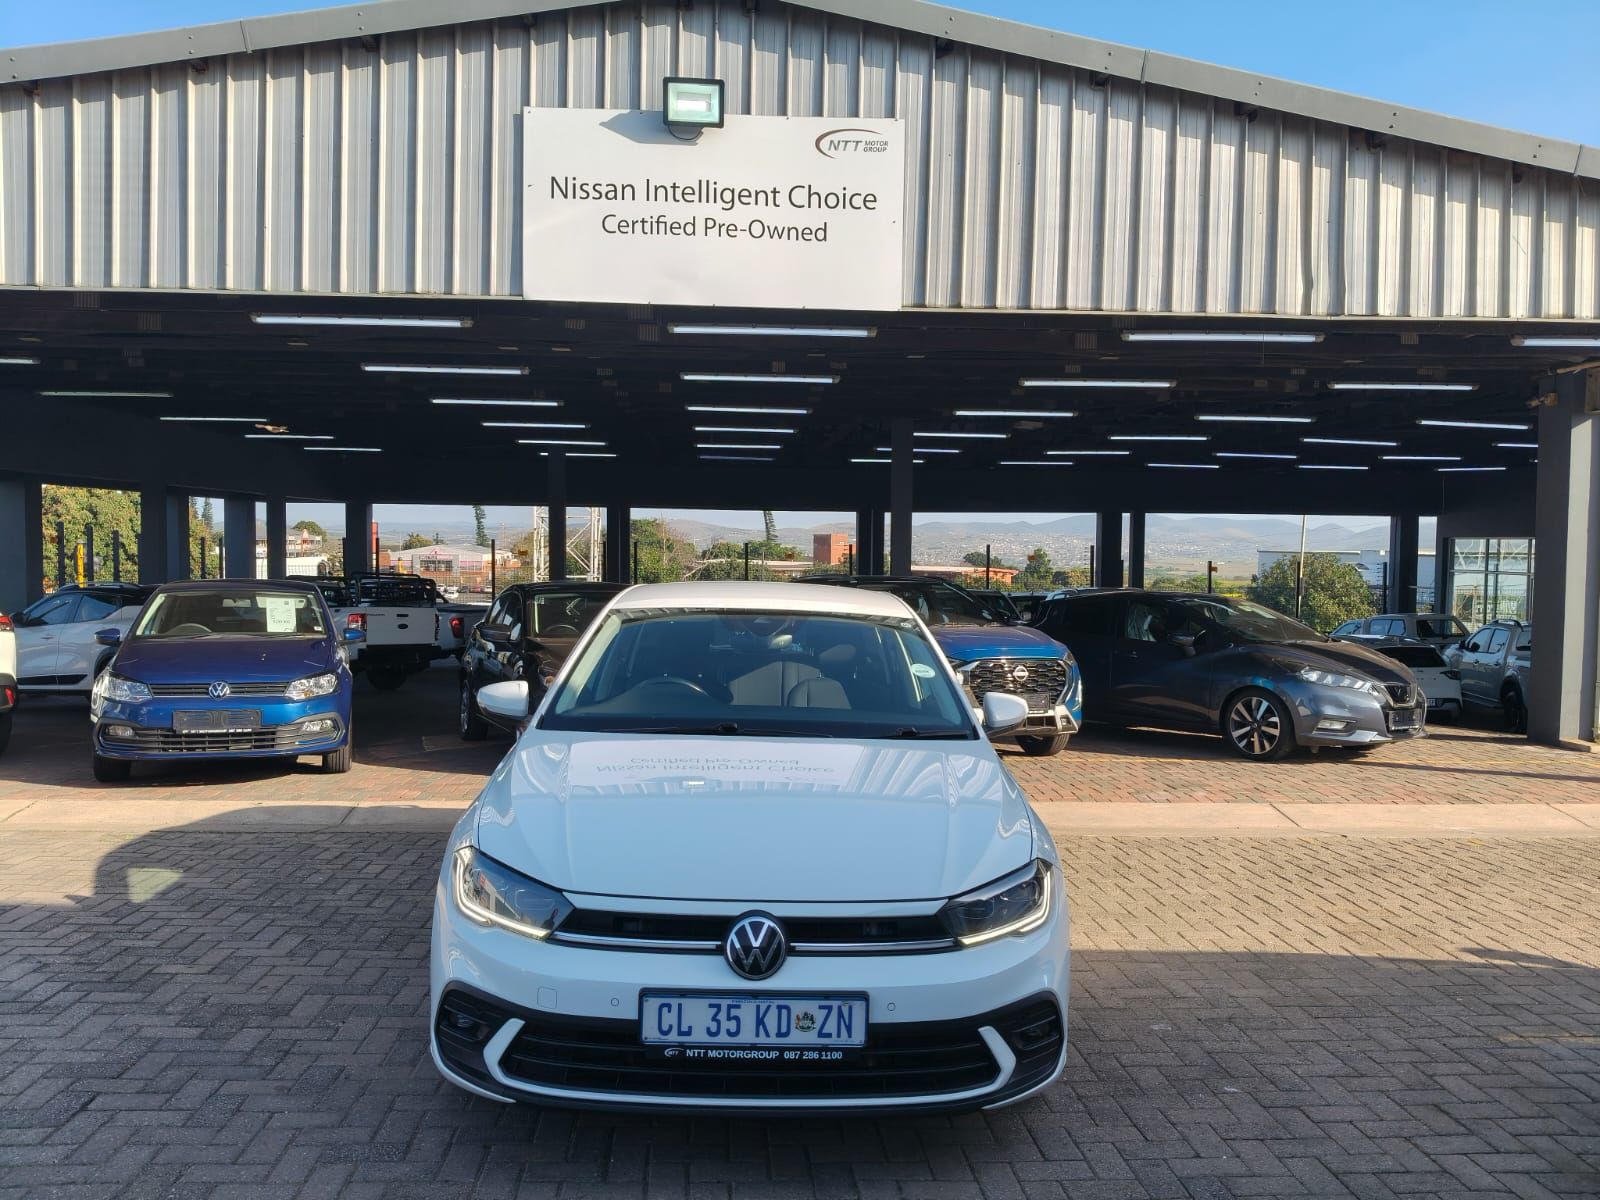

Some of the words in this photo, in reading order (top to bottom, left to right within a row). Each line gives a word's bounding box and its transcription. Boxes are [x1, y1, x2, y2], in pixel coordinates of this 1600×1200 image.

[828, 139, 863, 152] NTT
[550, 175, 636, 201] Nissan
[646, 178, 781, 212] Intelligent
[788, 184, 878, 211] Choice
[601, 213, 696, 237] Certified
[704, 217, 828, 242] Pre-Owned
[727, 916, 785, 979] VW
[657, 1002, 693, 1037] CL
[706, 1003, 742, 1038] 35
[755, 1004, 792, 1039] KD
[817, 1004, 853, 1039] ZN
[686, 1049, 706, 1057] NTT
[707, 1049, 780, 1059] MOTORGROUP
[784, 1051, 801, 1059] 087
[802, 1051, 820, 1060] 286
[821, 1051, 843, 1060] 1100
